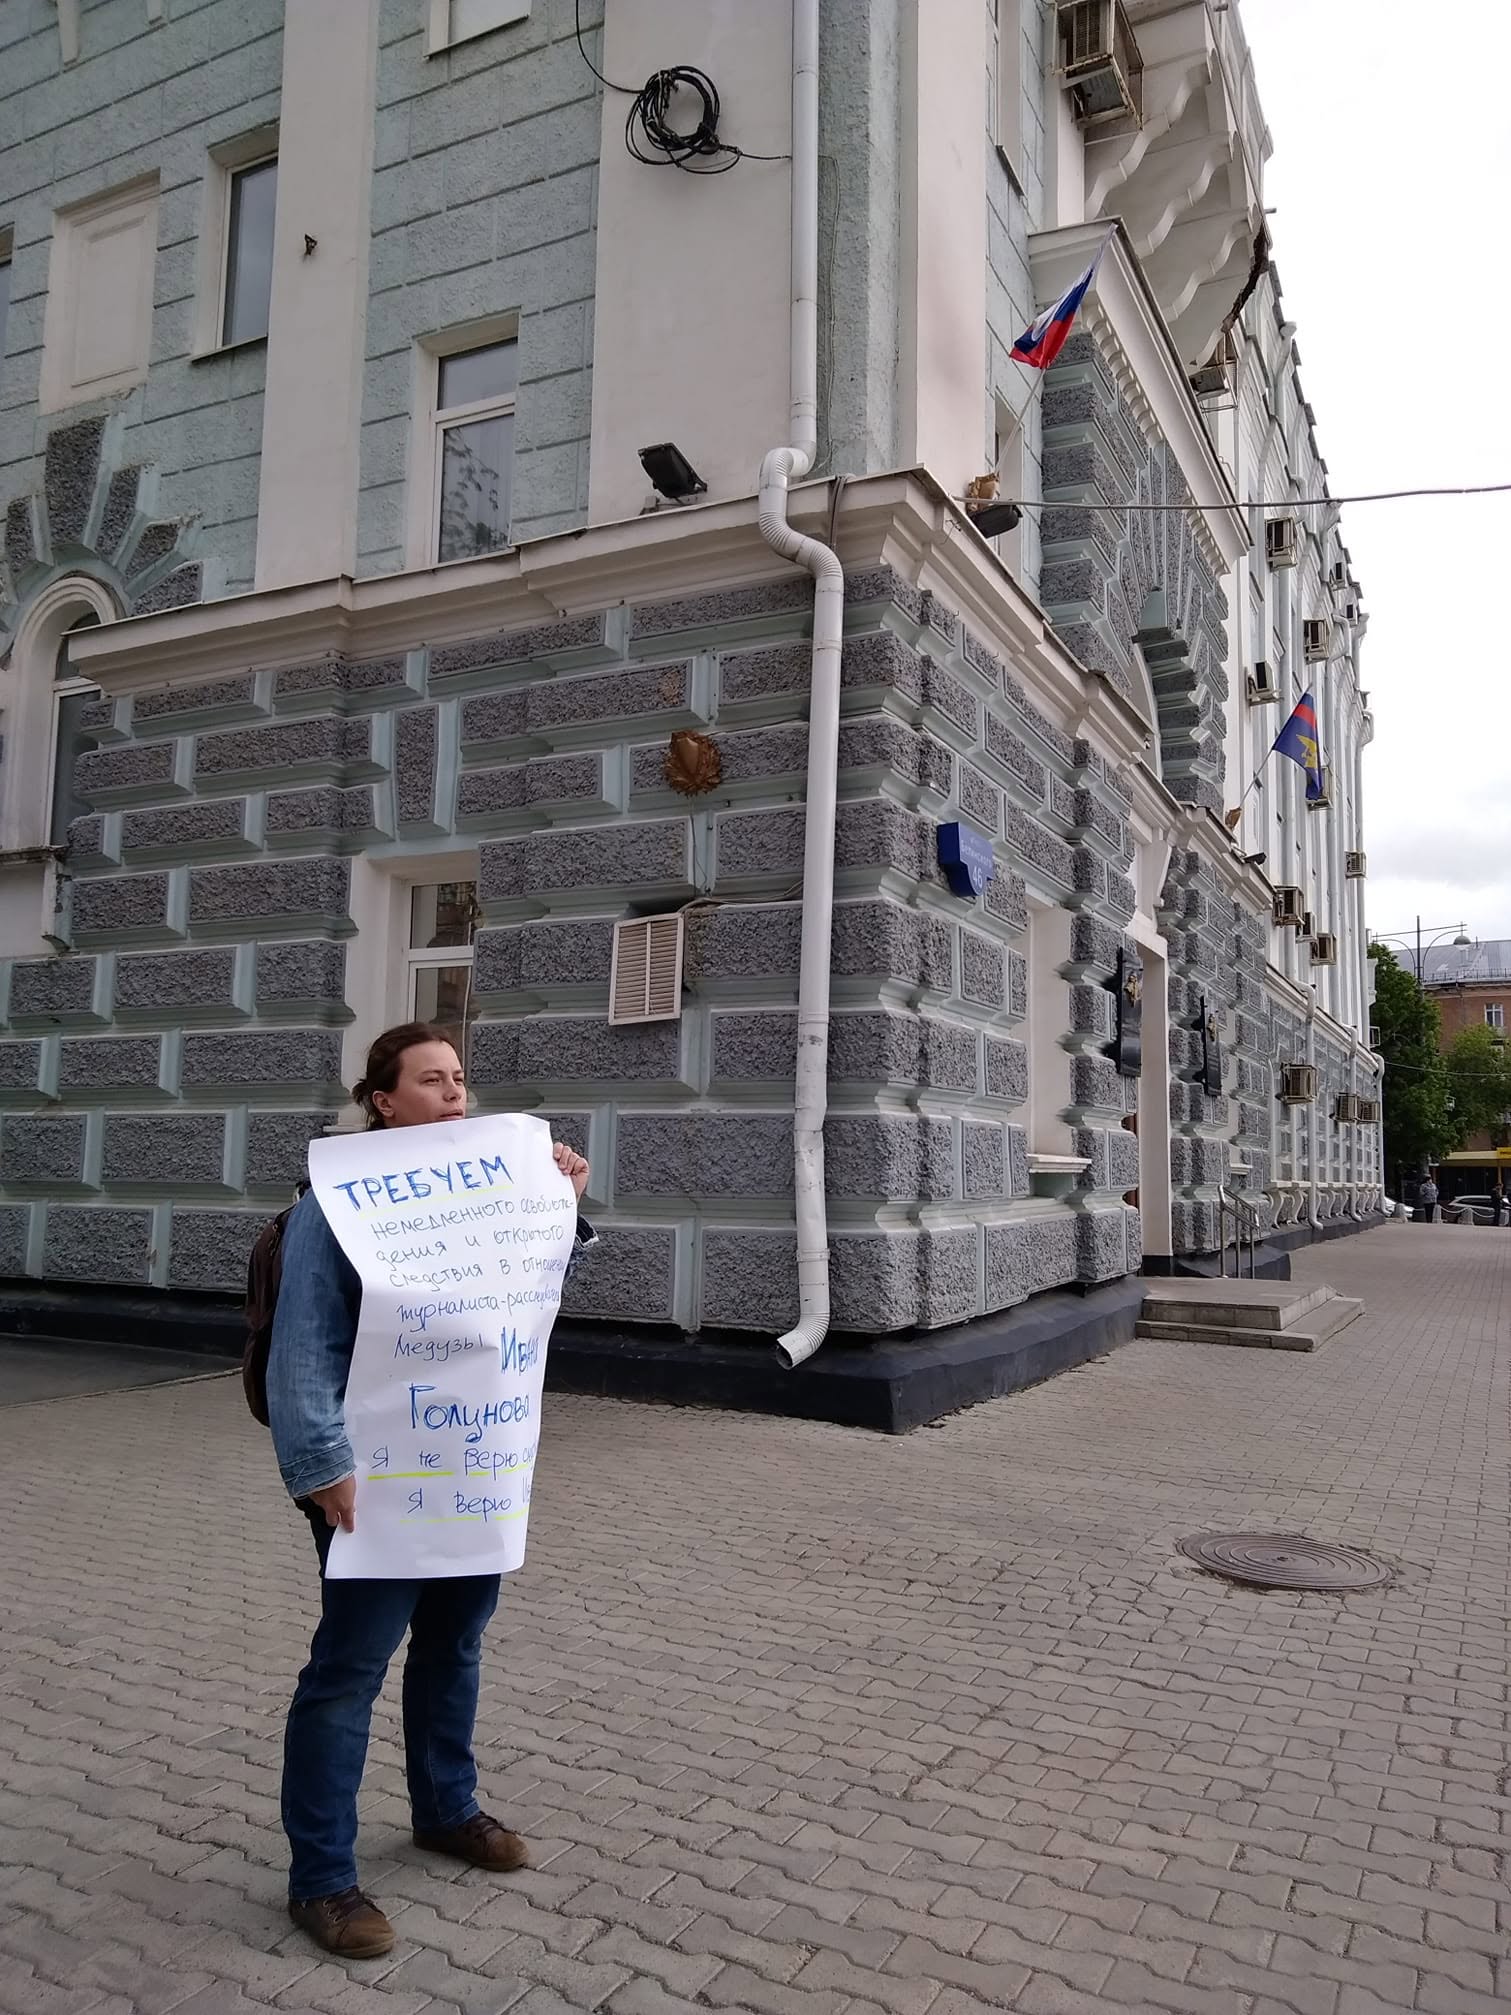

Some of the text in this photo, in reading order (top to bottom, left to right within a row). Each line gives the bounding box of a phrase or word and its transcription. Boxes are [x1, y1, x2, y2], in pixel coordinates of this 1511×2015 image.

[972, 866, 983, 889] 46
[333, 1155, 514, 1211] ТРЕБУЕМ
[371, 1199, 514, 1241] немедленного
[375, 1224, 563, 1272] дения и открытого
[371, 1446, 389, 1469] Я
[418, 1451, 443, 1468] не
[407, 1488, 423, 1514] Я
